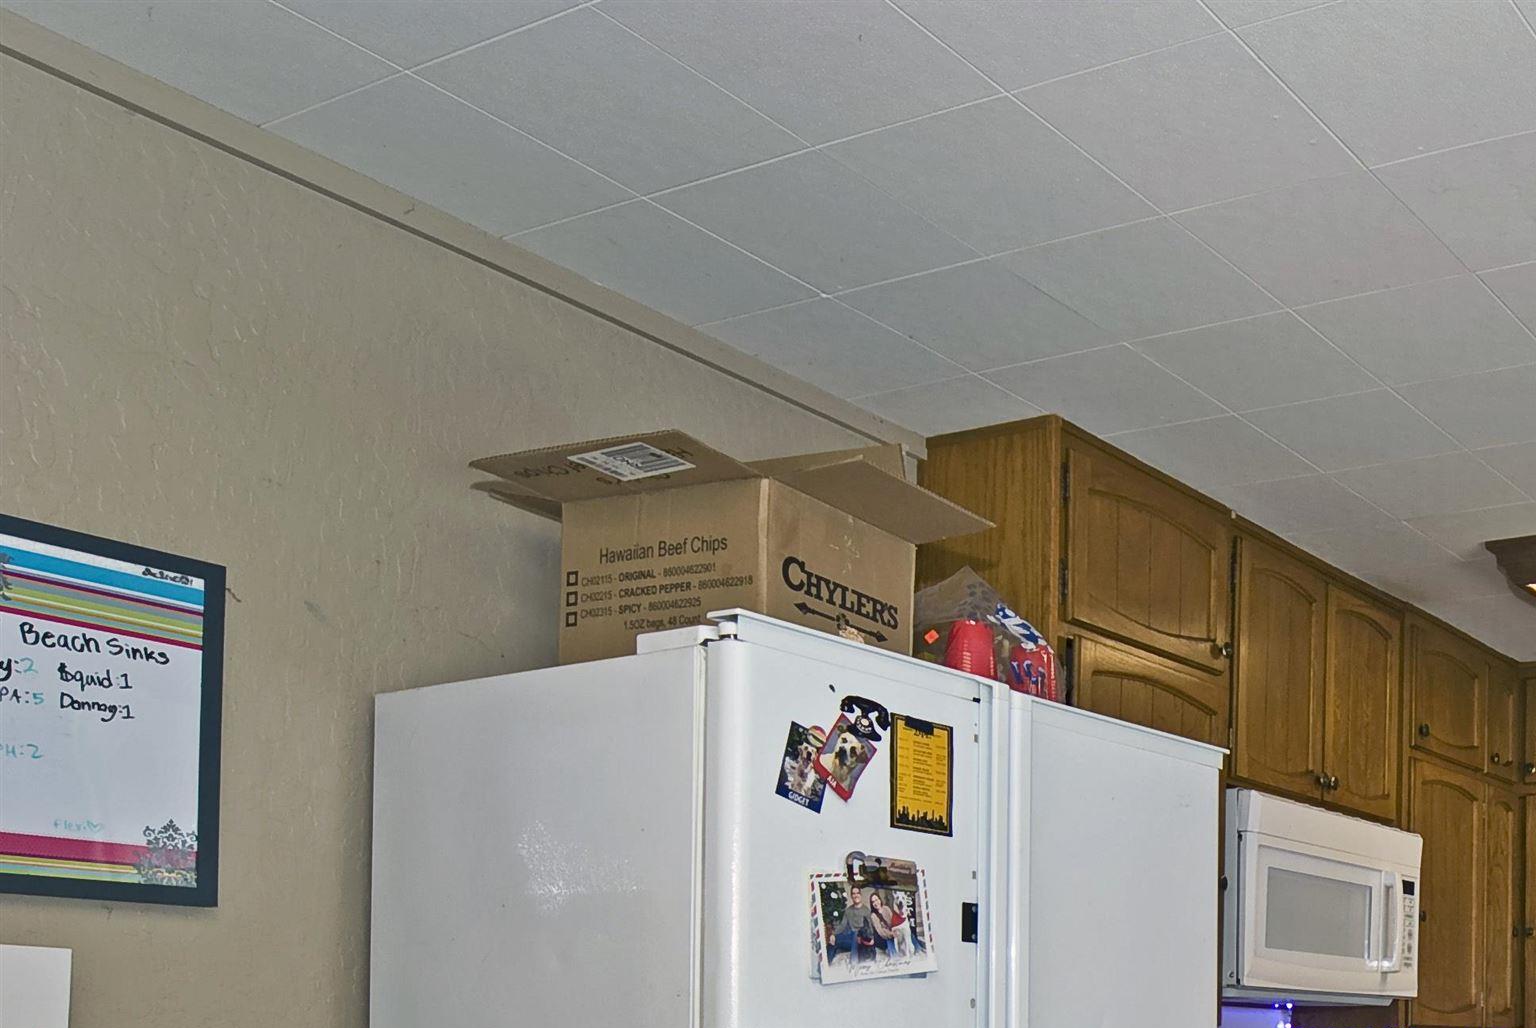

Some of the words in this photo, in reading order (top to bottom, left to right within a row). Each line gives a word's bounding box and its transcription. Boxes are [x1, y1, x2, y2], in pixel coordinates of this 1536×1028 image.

[600, 544, 654, 564] Hawaiian
[658, 538, 687, 558] Beef
[691, 536, 728, 555] Chips
[618, 569, 656, 582] ORIGINAL
[618, 585, 657, 598] CRACKED
[659, 582, 692, 595] PEPPER
[618, 603, 642, 615] SPICY
[19, 622, 101, 653] Beach
[106, 638, 170, 665] Sinks
